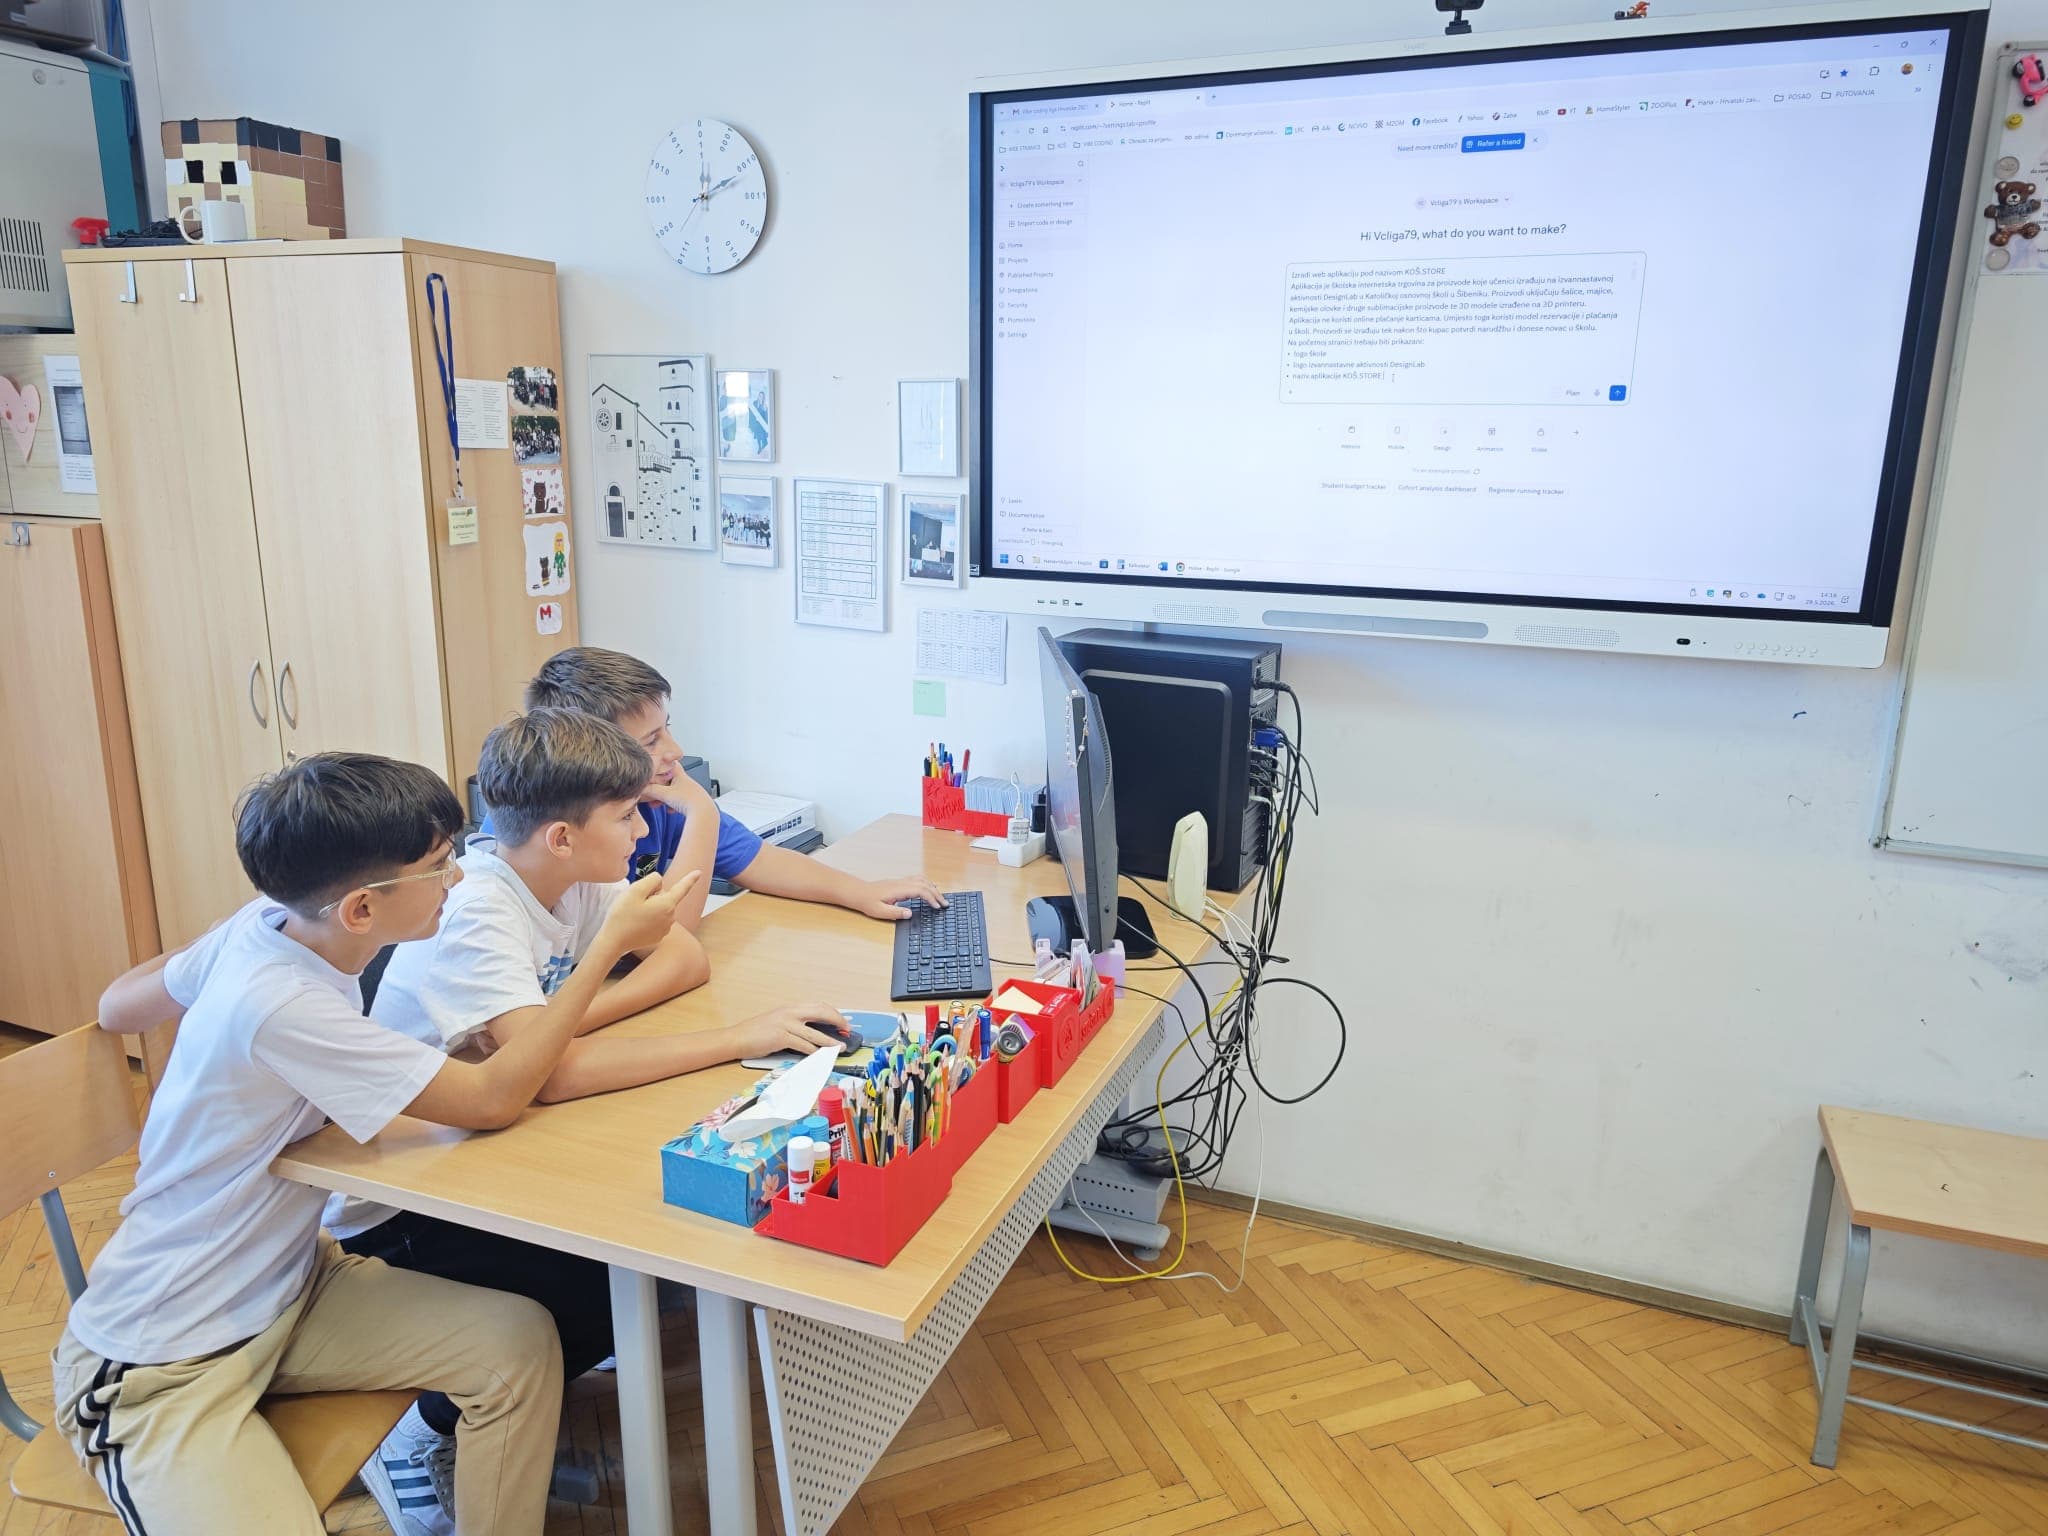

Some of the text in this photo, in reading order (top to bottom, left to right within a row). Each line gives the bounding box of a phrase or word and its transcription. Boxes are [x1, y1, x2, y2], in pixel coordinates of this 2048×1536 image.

[1788, 92, 1811, 100] POSAO
[1836, 89, 1875, 97] PUTOVANJA
[1596, 104, 1630, 114] HomeStyler
[1422, 117, 1448, 125] Facebook
[1433, 142, 1458, 150] credits?
[650, 159, 670, 175] 1010
[737, 154, 756, 172] 0010
[745, 192, 766, 200] 0011
[1464, 197, 1499, 205] Workspace
[740, 219, 760, 237] 0100
[1360, 224, 1566, 242] Hi Vcliga79, what do you want to make?
[1328, 270, 1359, 279] aplikaciju
[1361, 270, 1373, 278] pod
[1291, 282, 1322, 291] Aplikacija
[1324, 282, 1330, 290] je
[1398, 280, 1425, 288] trgovina
[1437, 279, 1471, 287] proizvode
[1473, 278, 1487, 286] koje
[1489, 277, 1514, 285] učenici
[1517, 276, 1545, 285] izrađuju
[1558, 275, 1614, 284] izvannastavnoj
[1324, 293, 1357, 302] DesignLab
[1365, 292, 1398, 301] Katoličkoj
[1400, 292, 1430, 300] osnovnoj
[1457, 289, 1489, 298] Šibeniku.
[1492, 289, 1523, 297] Proizvodi
[1526, 289, 1559, 297] uključuju
[1587, 288, 1613, 296] majice,
[1290, 305, 1318, 313] kemijske
[1347, 305, 1365, 313] druge
[1368, 303, 1412, 312] sublimacijske
[1415, 303, 1449, 312] proizvode
[1555, 301, 1586, 309] printeru.
[1376, 314, 1404, 324] plaćanje
[1444, 314, 1472, 322] Umjesto
[1516, 312, 1538, 320] model
[1541, 312, 1580, 321] rezervacije
[1586, 311, 1618, 320] plaćanja
[1353, 327, 1380, 335] izrađuju
[1429, 326, 1449, 334] kupac
[1298, 338, 1326, 347] početnoj
[1354, 338, 1377, 346] trebaju
[1392, 338, 1424, 346] prikazani:
[1294, 350, 1307, 358] logo
[1311, 372, 1341, 380] aplikacije
[1420, 485, 1442, 493] analysis
[1444, 485, 1477, 493] dashboard
[1489, 487, 1515, 495] Beginner
[1517, 488, 1540, 496] running
[540, 605, 551, 620] M
